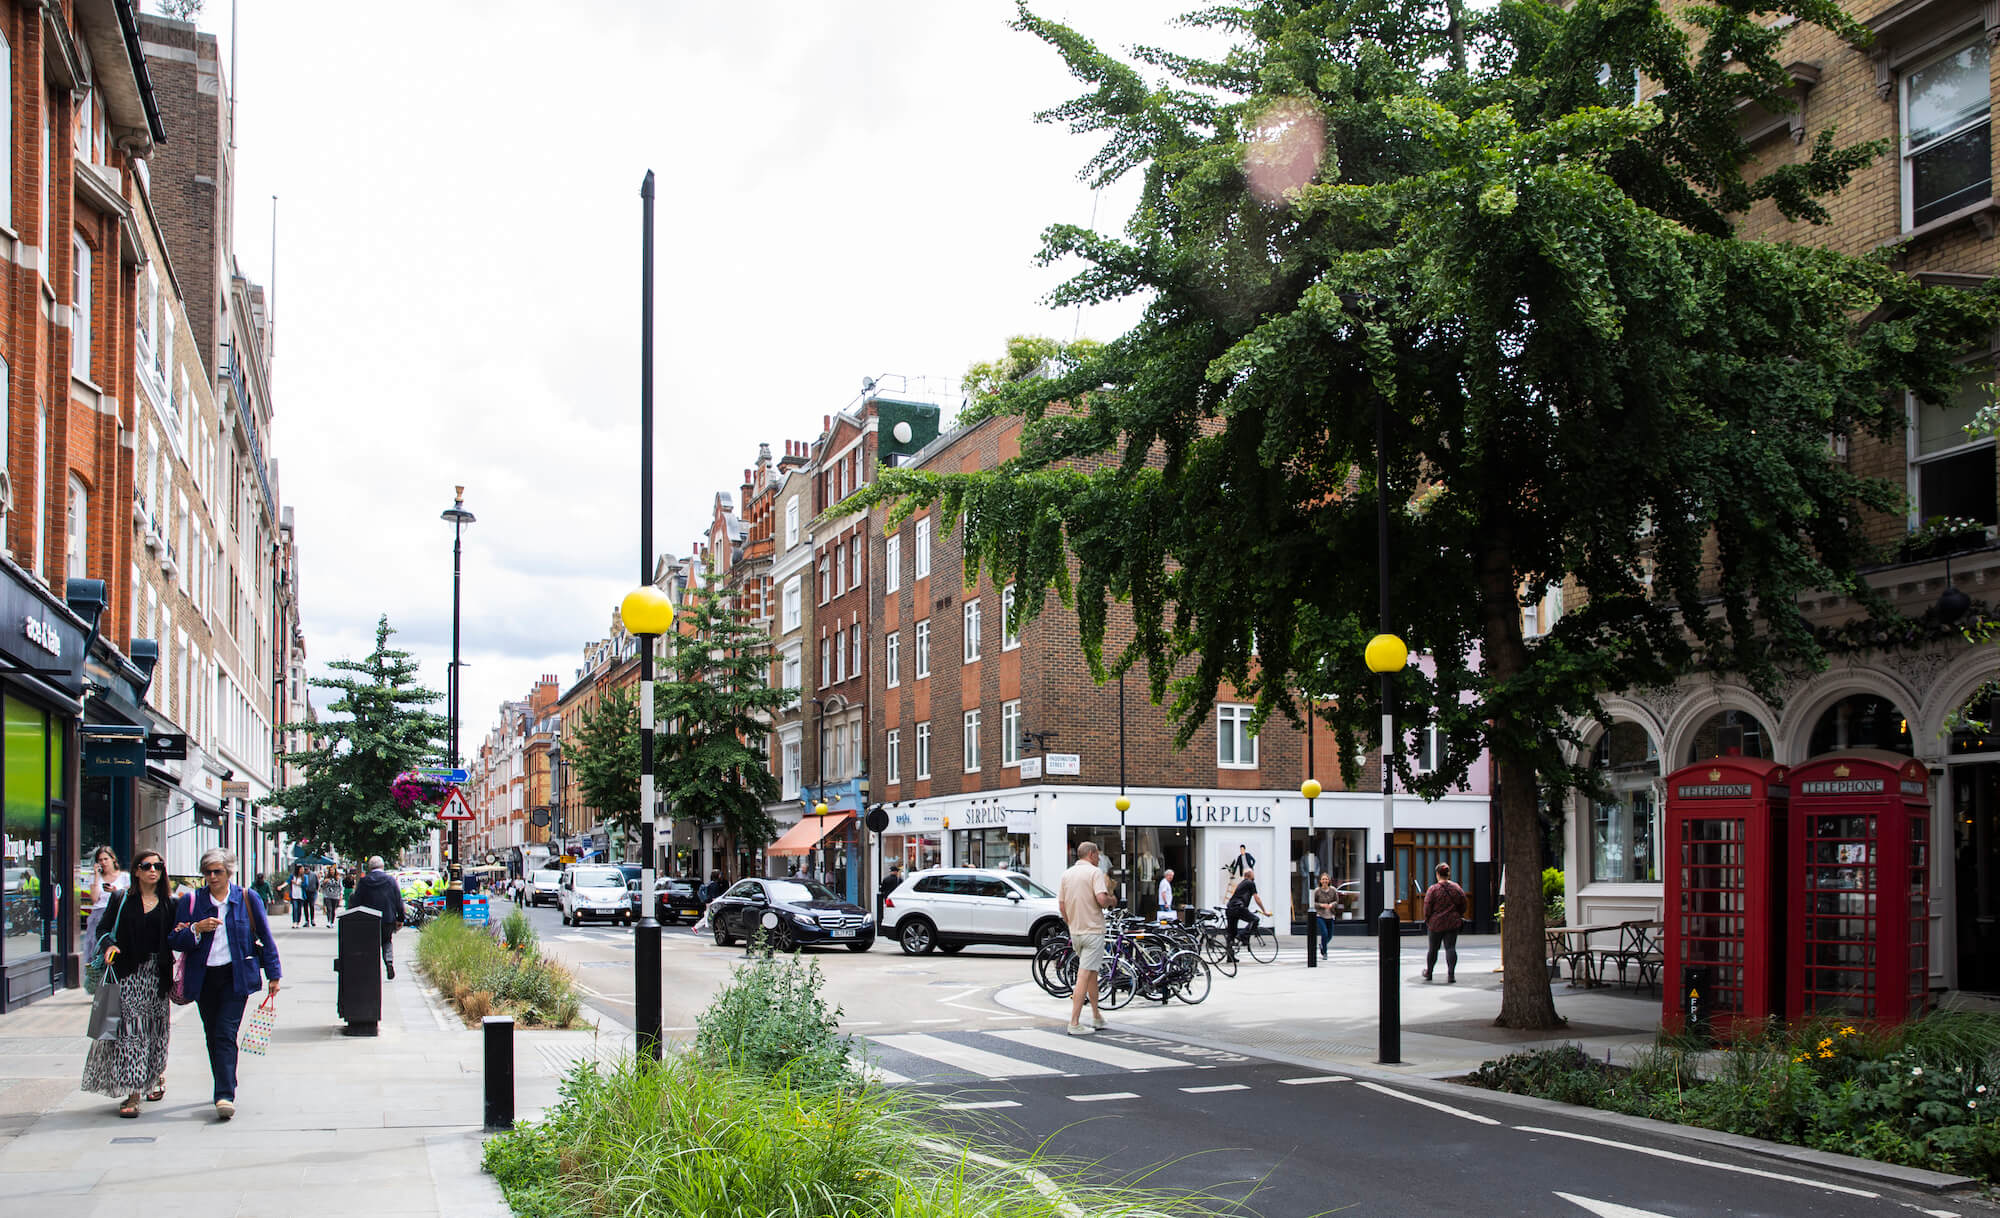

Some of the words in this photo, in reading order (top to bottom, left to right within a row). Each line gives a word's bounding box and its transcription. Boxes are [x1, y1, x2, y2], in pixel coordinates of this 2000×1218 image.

[1681, 785, 1752, 796] TELEPHONE
[1804, 781, 1883, 793] TELEPHONE
[965, 805, 1007, 824] SIRPLUS
[1196, 806, 1272, 822] IRPLUS
